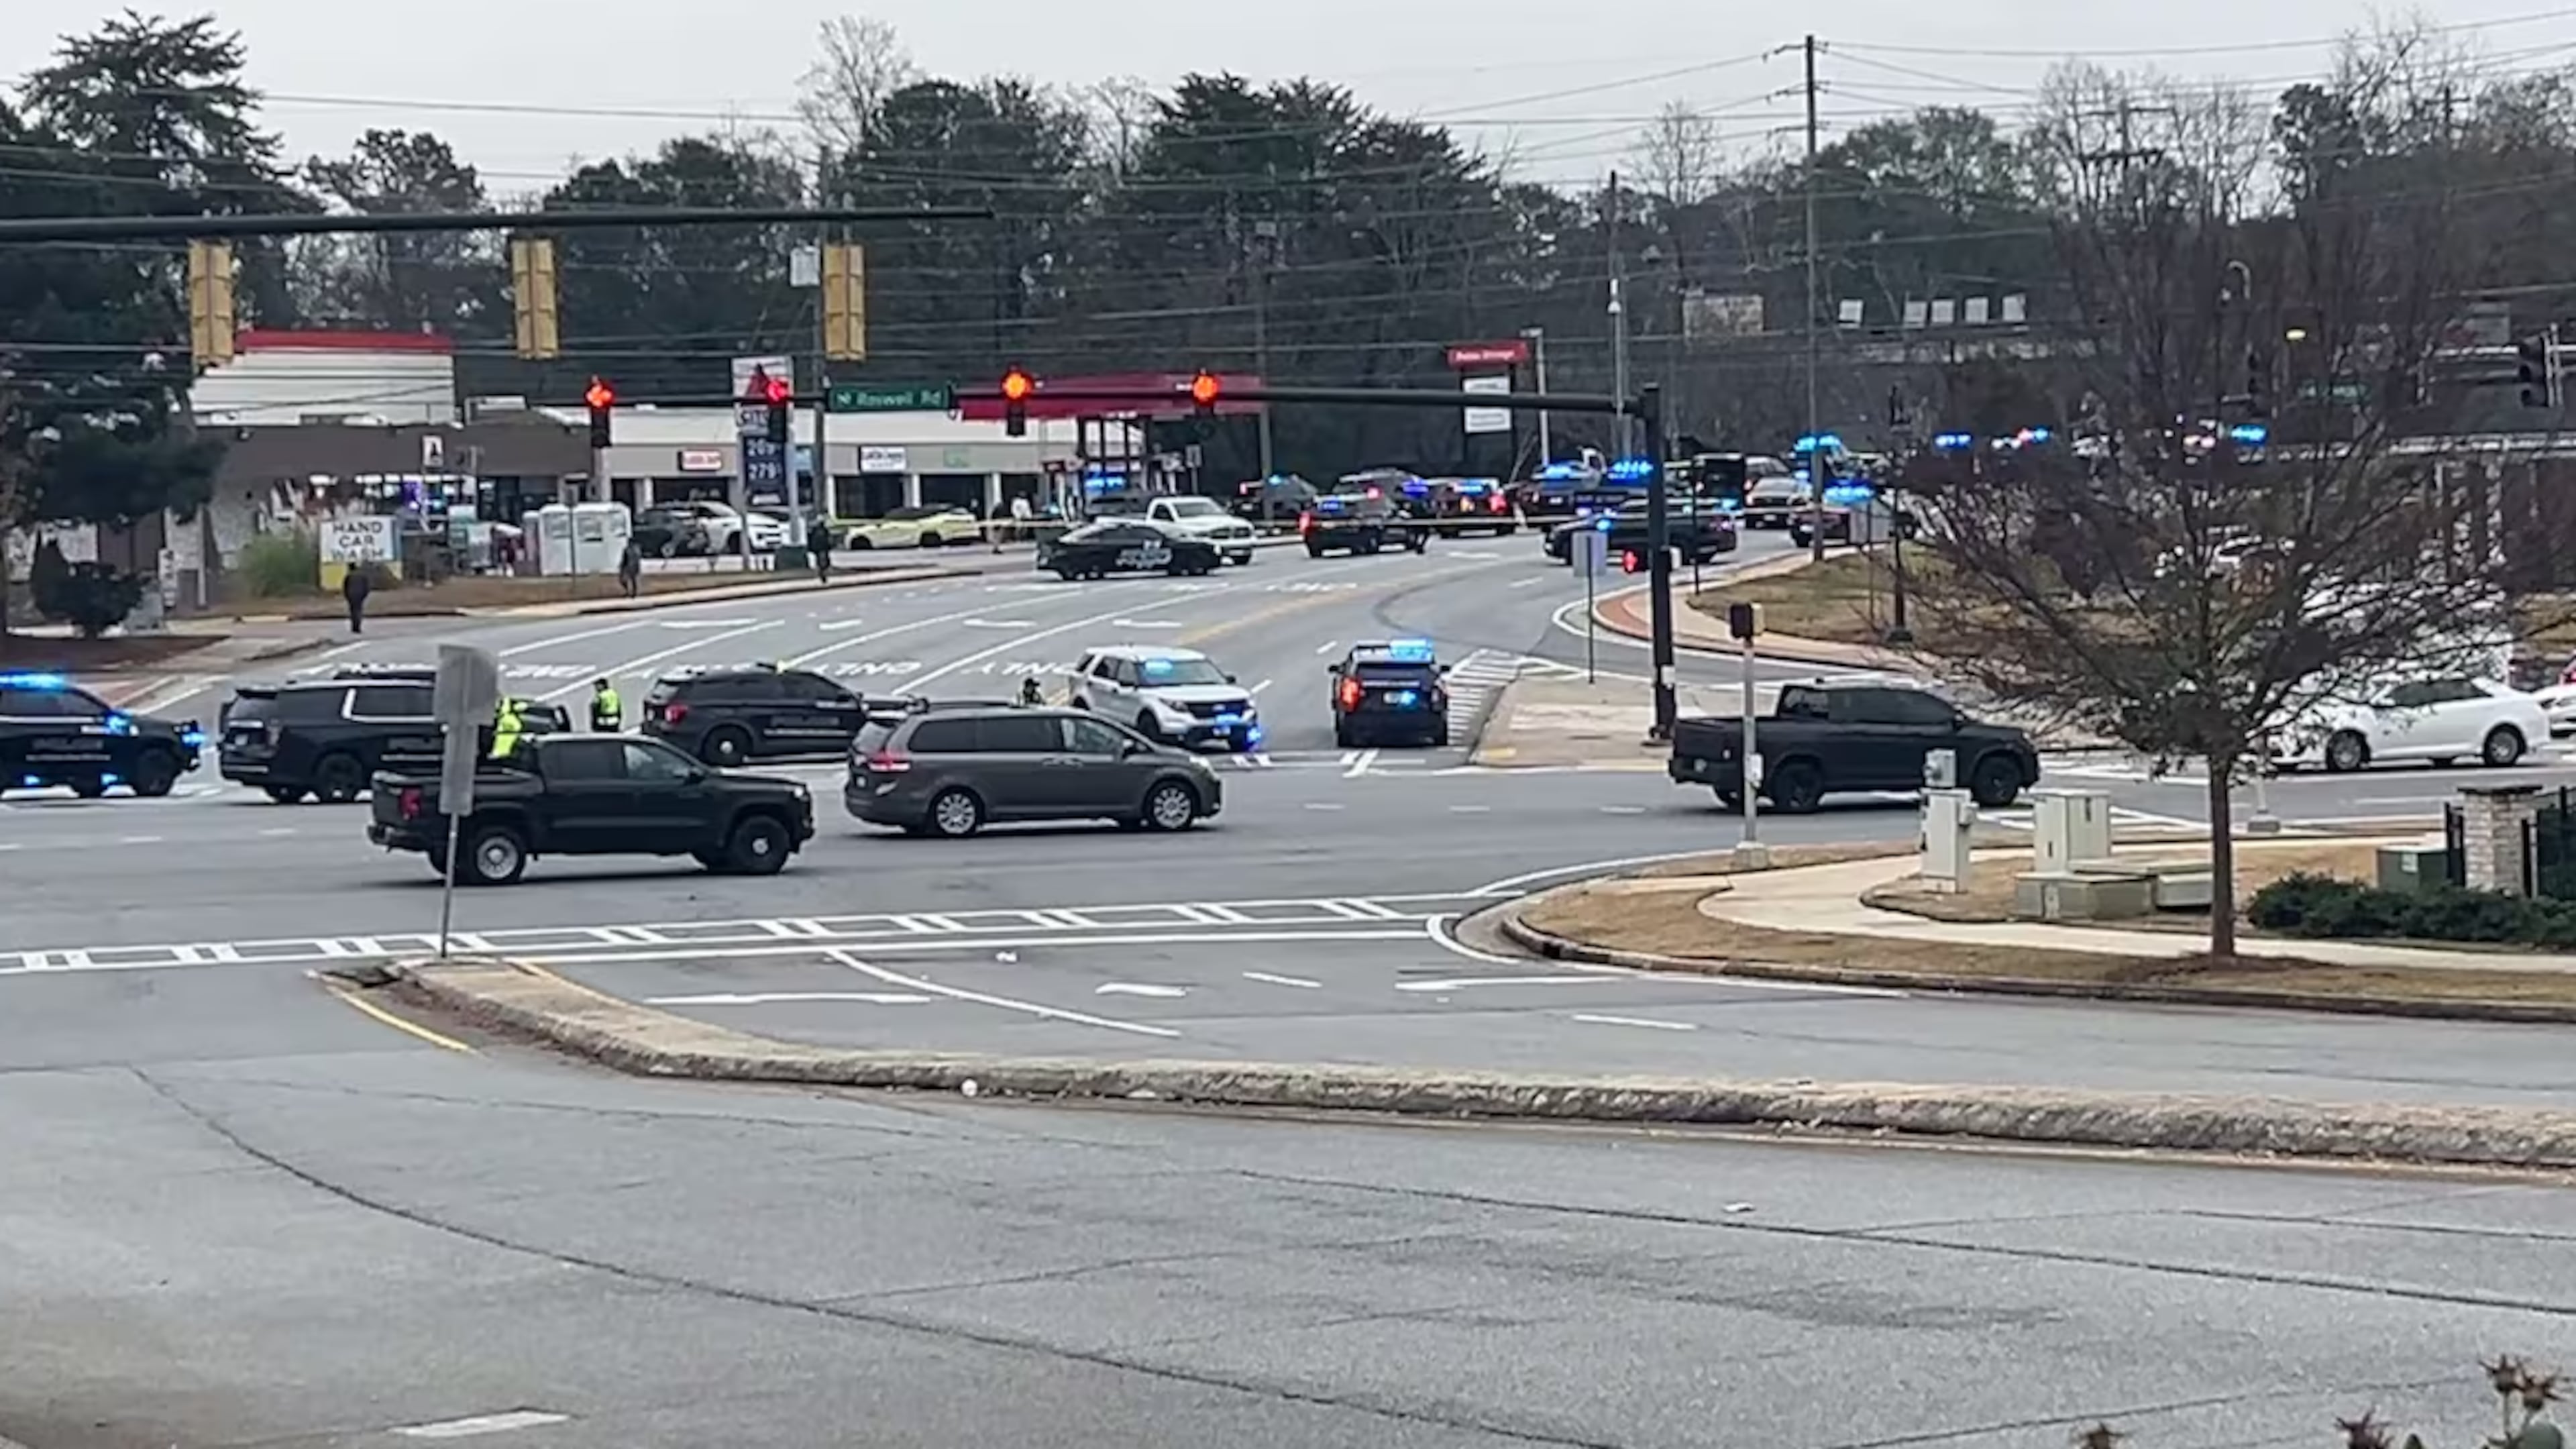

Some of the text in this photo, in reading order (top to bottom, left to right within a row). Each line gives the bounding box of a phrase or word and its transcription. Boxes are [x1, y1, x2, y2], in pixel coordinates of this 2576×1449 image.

[856, 391, 914, 407] Roswell
[920, 389, 942, 405] Rd
[333, 521, 383, 533] HAND
[339, 535, 375, 548] CAR
[331, 549, 384, 559] WASH
